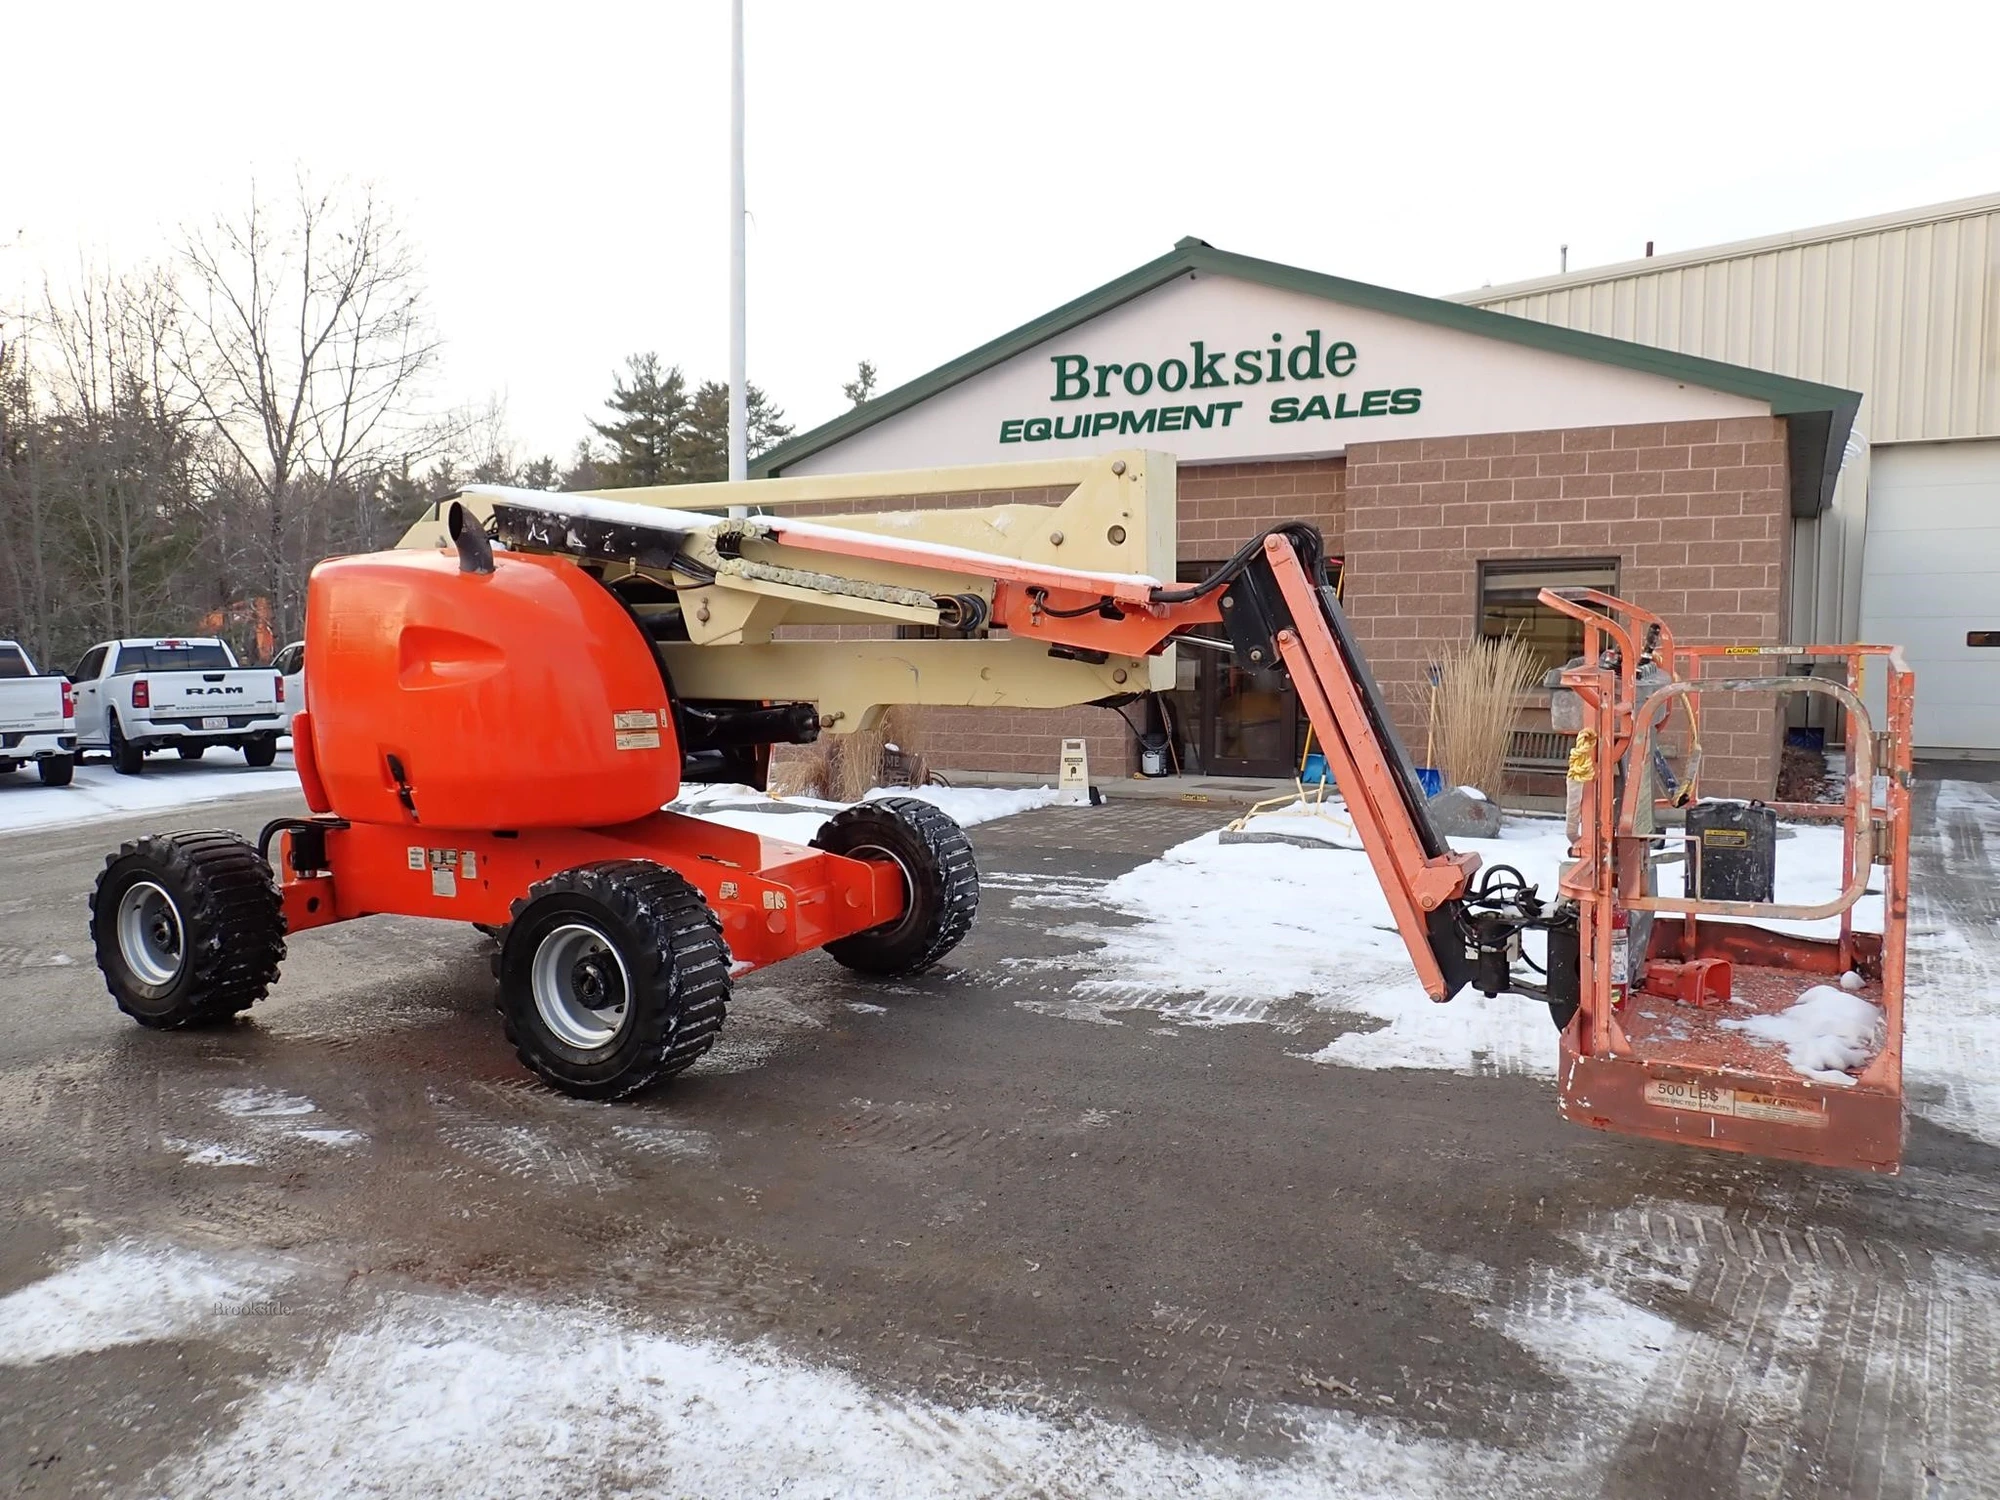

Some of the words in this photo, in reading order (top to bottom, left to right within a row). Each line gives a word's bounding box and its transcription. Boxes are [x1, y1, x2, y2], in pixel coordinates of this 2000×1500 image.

[1050, 329, 1357, 402] Brookside
[999, 401, 1243, 443] EQUIPMENT
[1268, 387, 1422, 424] SALES
[186, 687, 243, 695] RAM
[1658, 1083, 1685, 1097] 500
[1699, 1101, 1730, 1112] CAPACITY
[1763, 1097, 1814, 1110] WARNING
